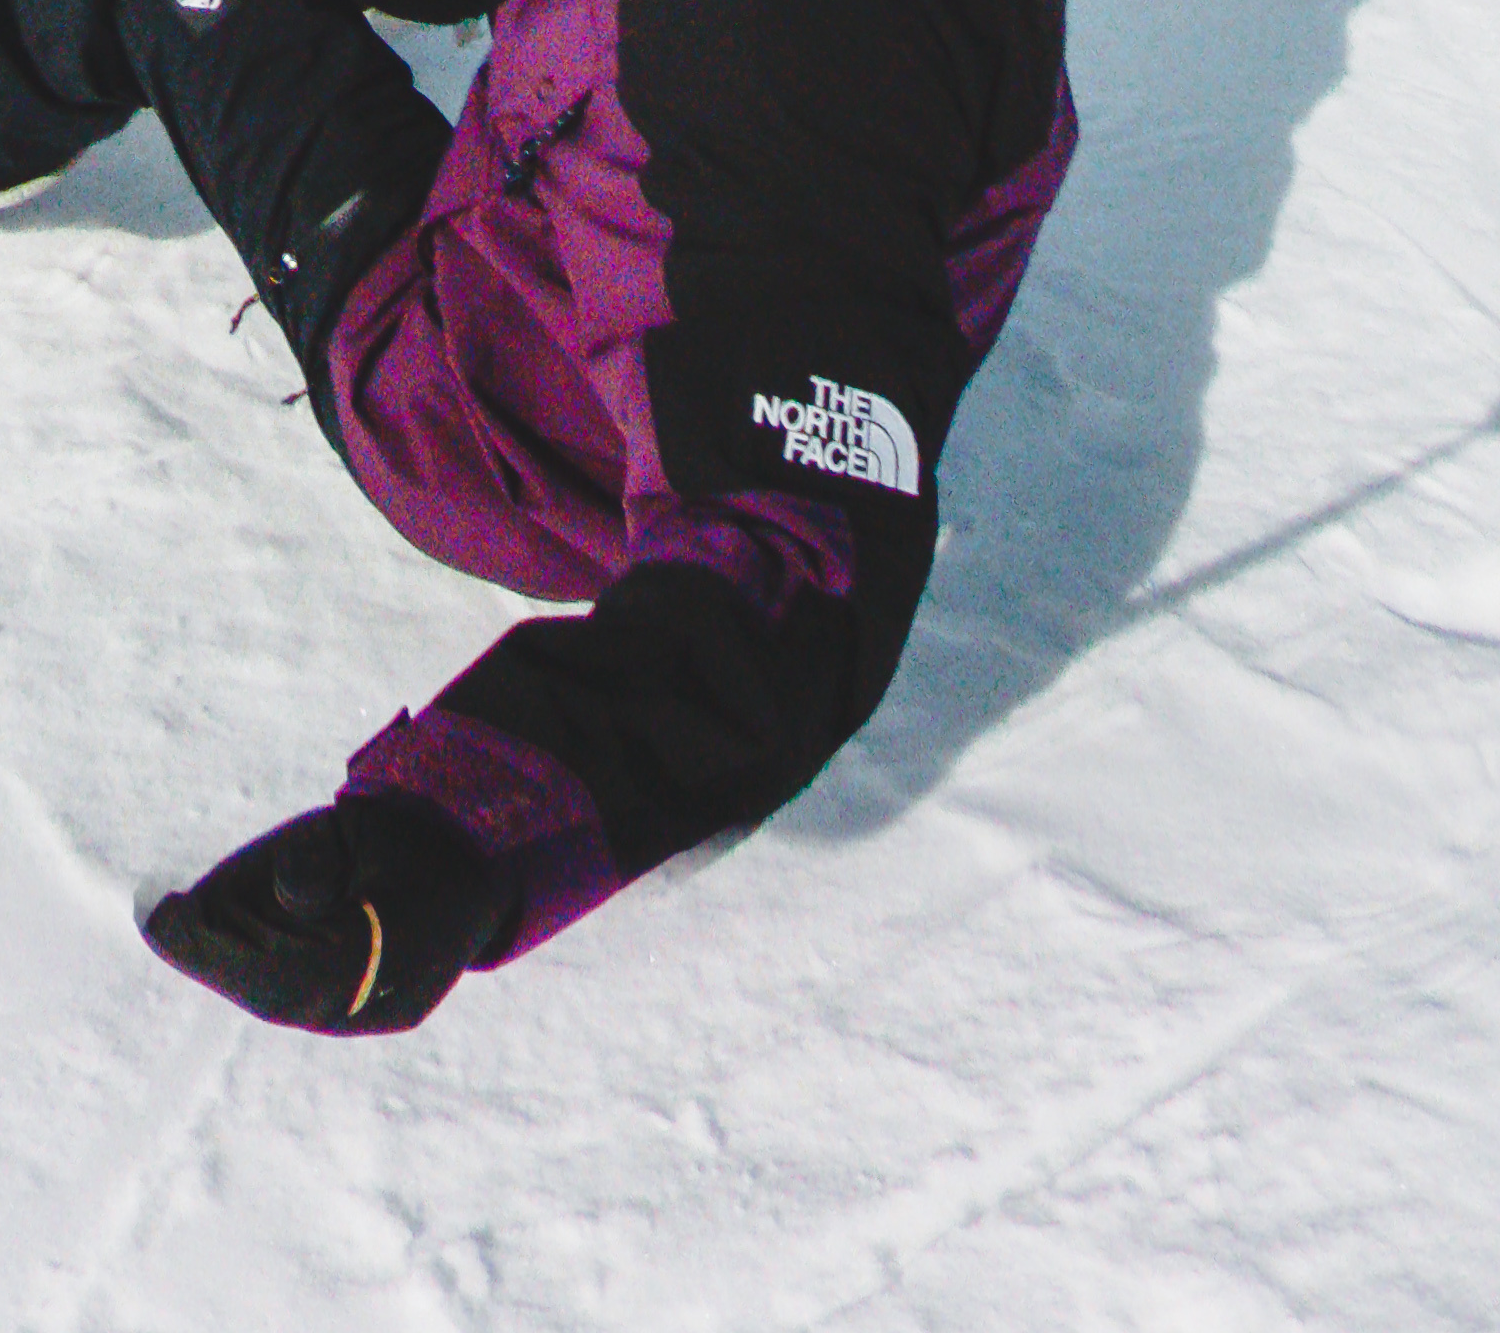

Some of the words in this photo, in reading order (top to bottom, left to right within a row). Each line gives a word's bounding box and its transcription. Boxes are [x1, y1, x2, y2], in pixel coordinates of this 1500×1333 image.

[752, 393, 870, 449] NORTH
[809, 374, 871, 419] THE
[783, 430, 868, 479] FACE
